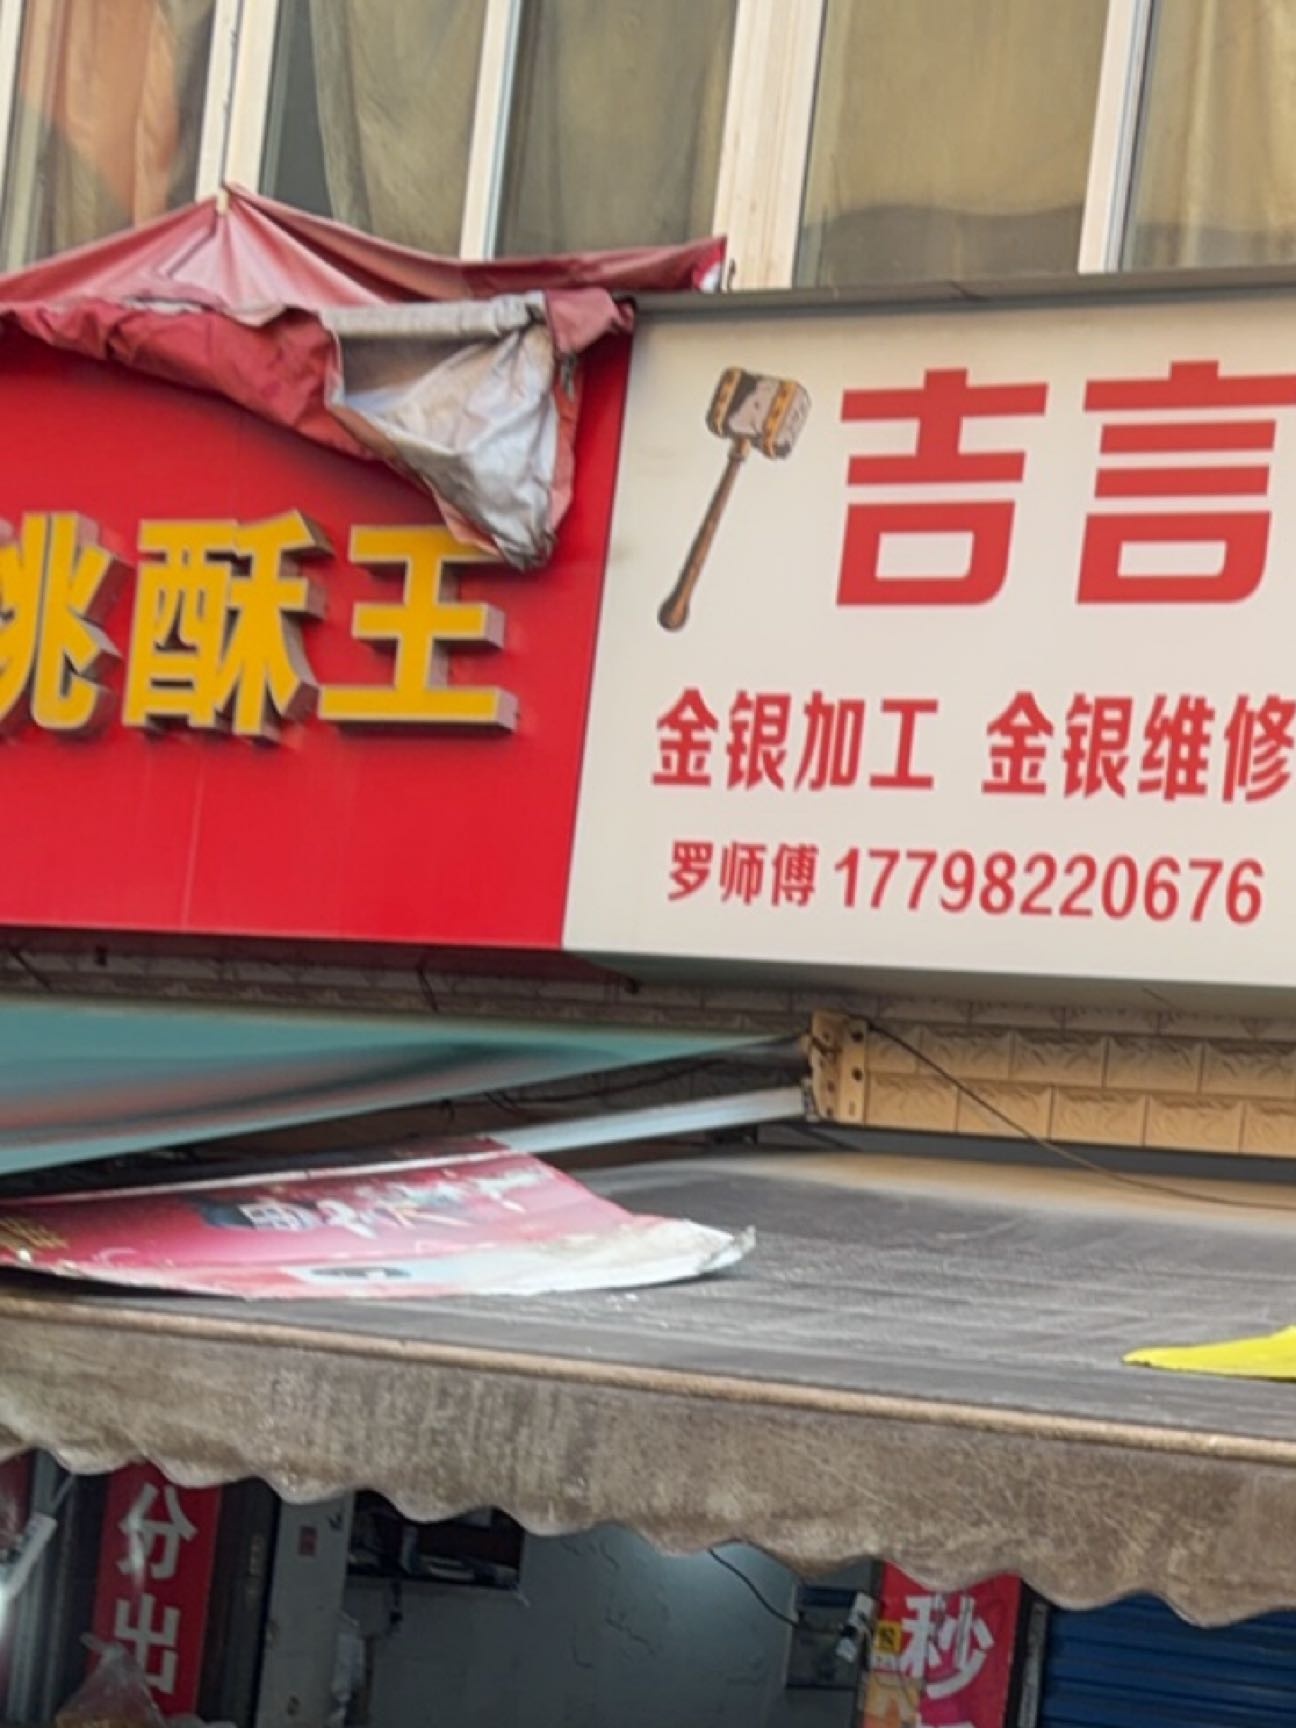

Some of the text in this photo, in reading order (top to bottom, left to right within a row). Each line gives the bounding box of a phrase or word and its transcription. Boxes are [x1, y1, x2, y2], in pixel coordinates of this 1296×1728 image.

[652, 689, 939, 791] 金银加工
[668, 840, 1264, 925] 罗师傅 17798220676
